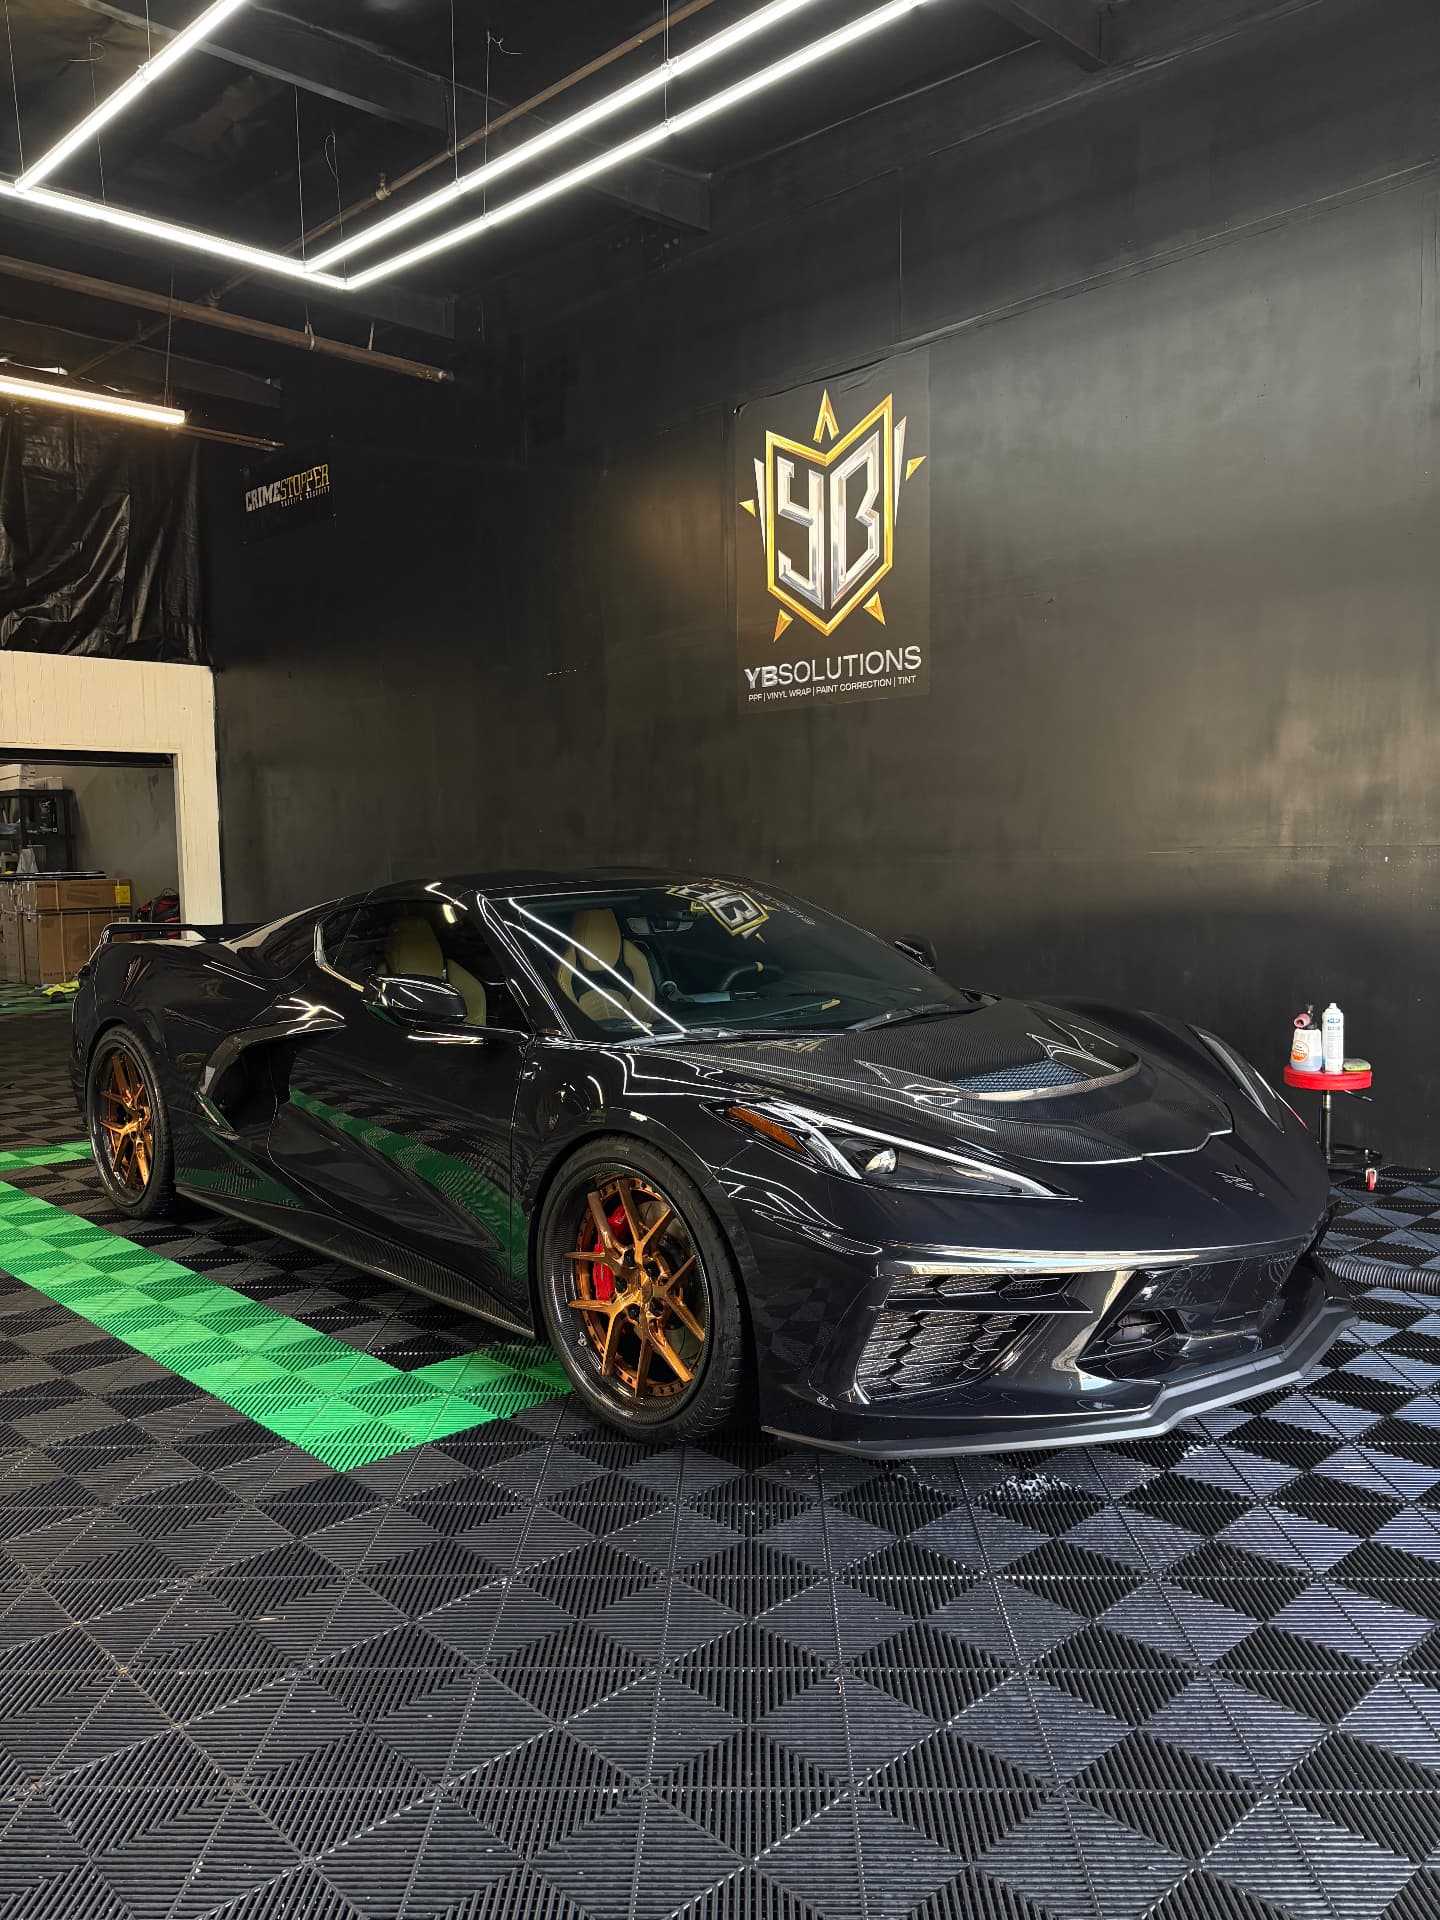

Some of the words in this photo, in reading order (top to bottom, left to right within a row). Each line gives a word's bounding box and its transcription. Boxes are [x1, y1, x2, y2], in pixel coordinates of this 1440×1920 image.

[245, 463, 330, 513] CRIMESTOPPER
[744, 645, 922, 690] YBSOLUTIONS
[748, 693, 763, 703] PPF
[767, 691, 788, 701] VINYL
[788, 687, 812, 698] WRAP
[815, 684, 839, 695] PAINT
[839, 677, 892, 692] CORRECTION
[897, 675, 917, 685] TINT
